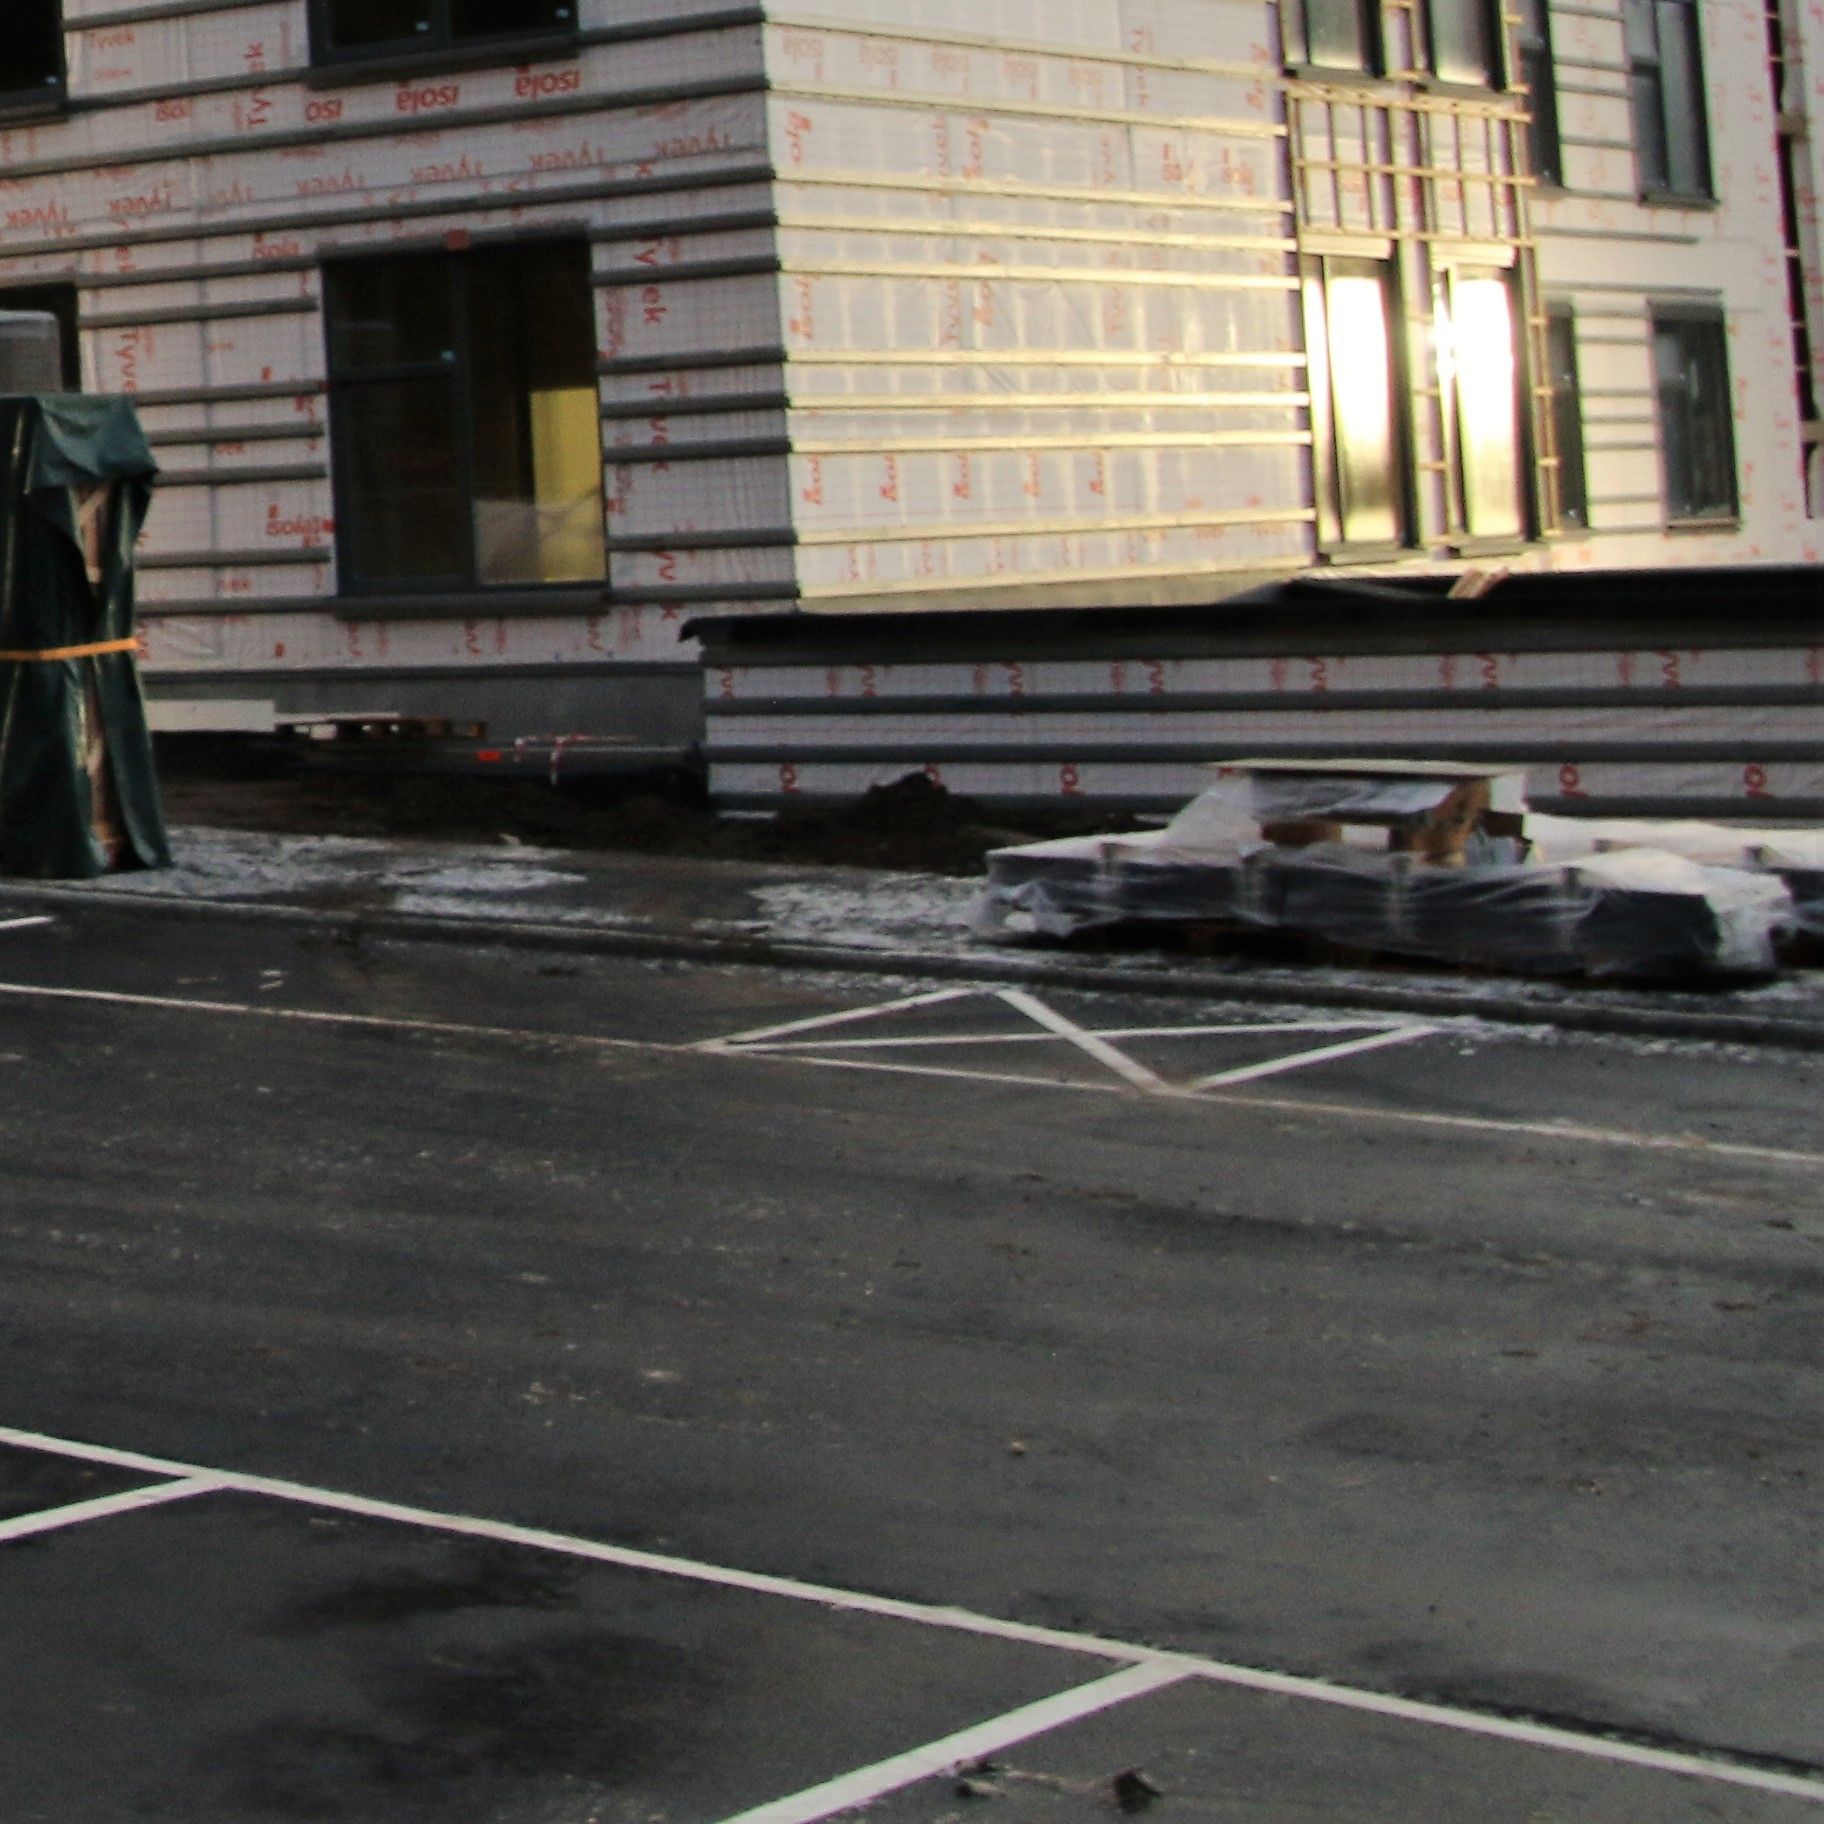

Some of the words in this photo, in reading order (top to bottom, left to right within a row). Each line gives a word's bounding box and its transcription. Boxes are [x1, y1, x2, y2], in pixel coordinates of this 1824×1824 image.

[396, 84, 459, 113] isola
[514, 67, 581, 97] isola
[115, 330, 140, 393] Tyve
